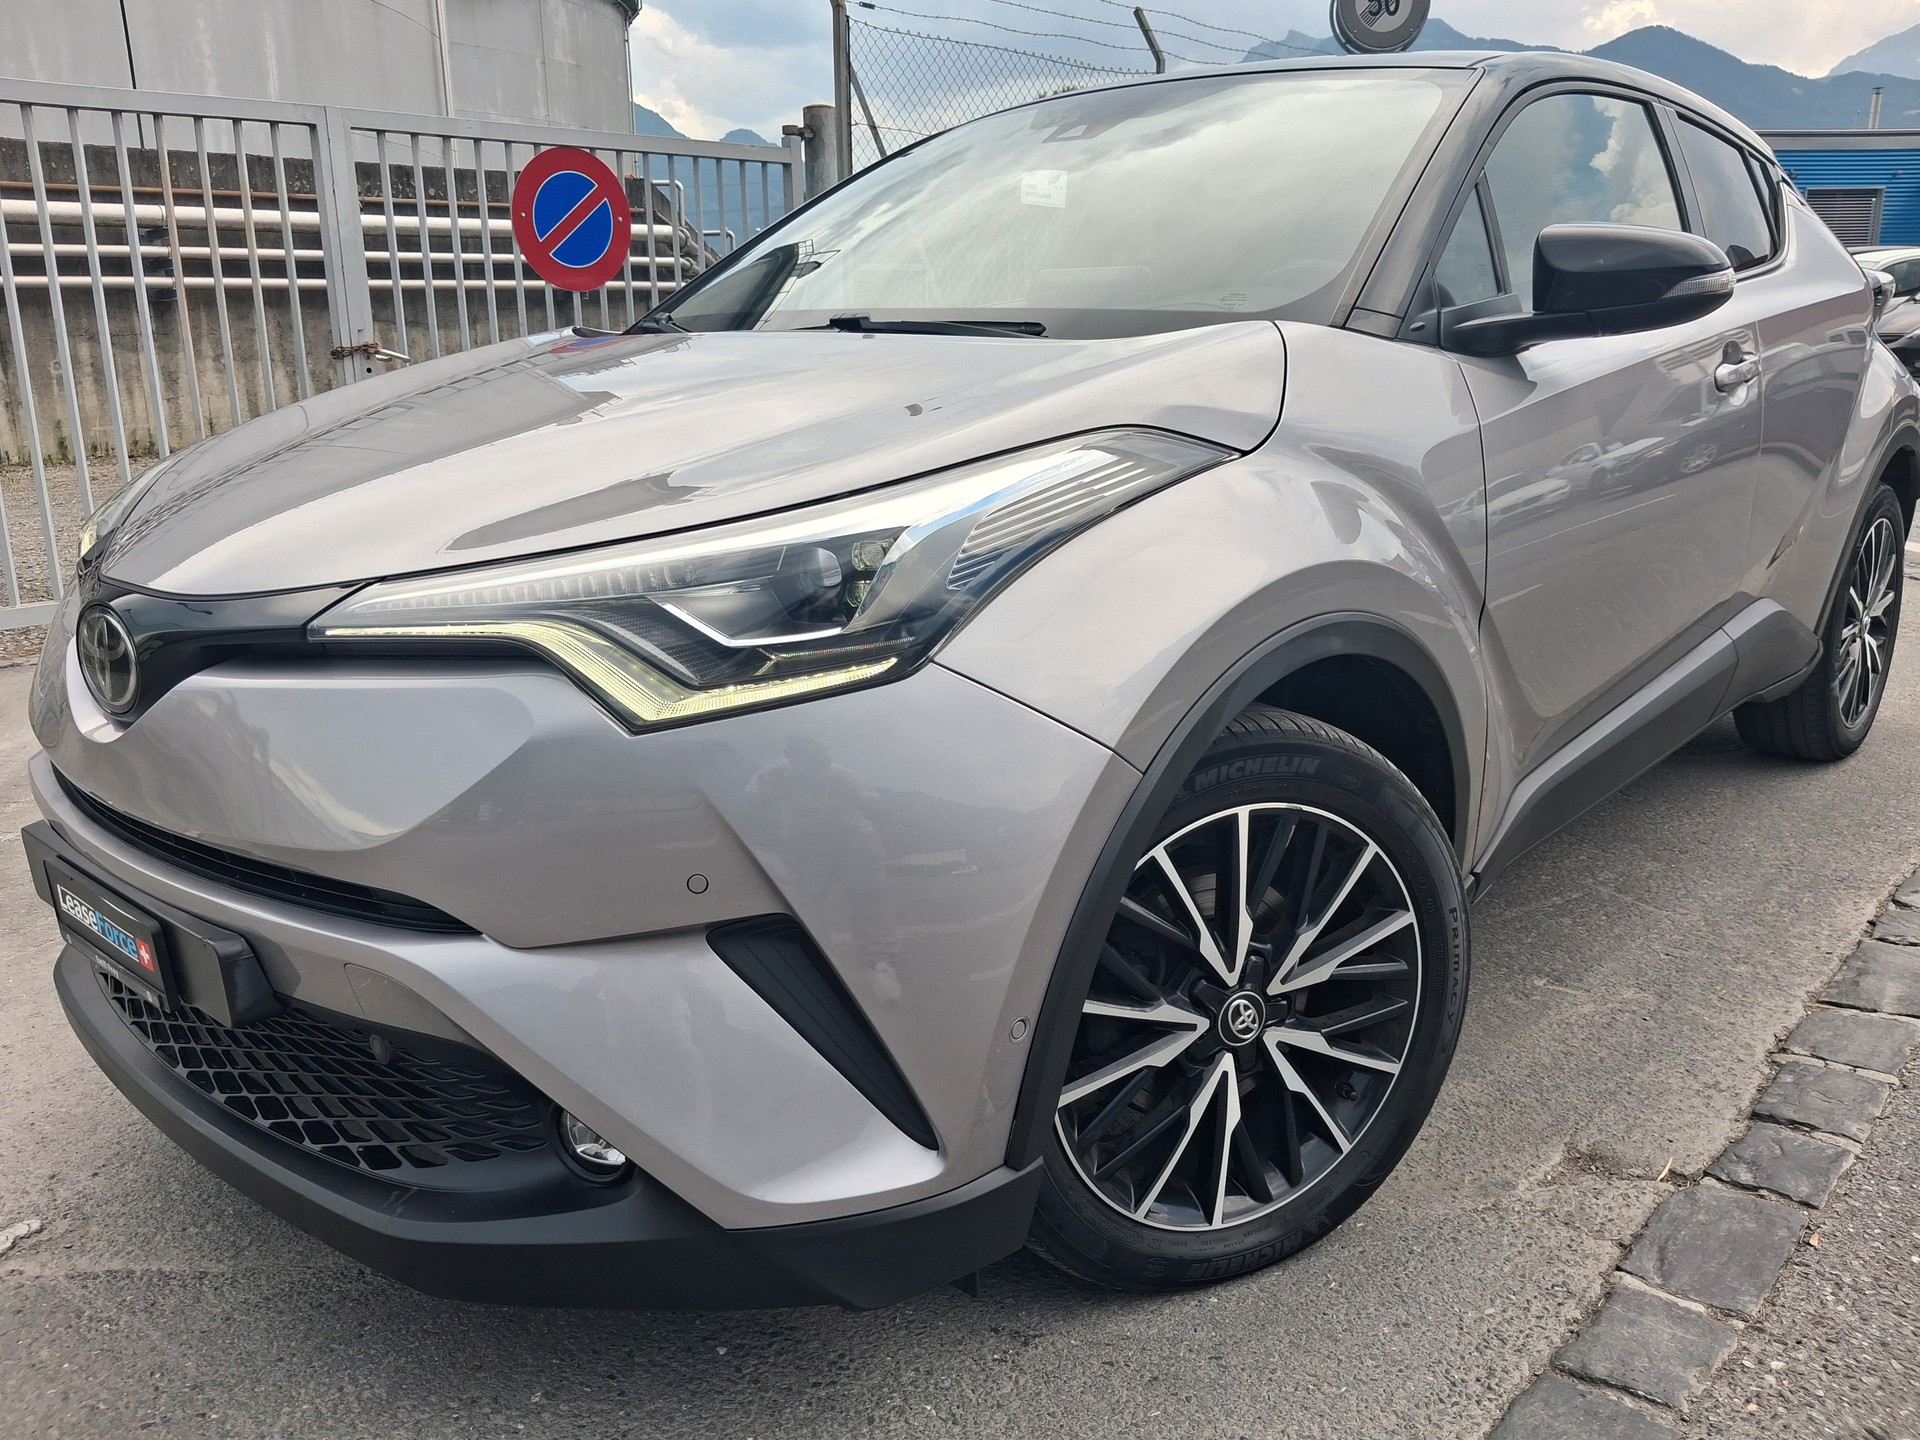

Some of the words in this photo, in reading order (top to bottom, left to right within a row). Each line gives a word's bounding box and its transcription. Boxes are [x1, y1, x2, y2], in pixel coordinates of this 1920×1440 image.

[1194, 756, 1321, 792] MICHELIN
[56, 883, 139, 959] LeaseForce
[1188, 1231, 1304, 1278] MICHELIN
